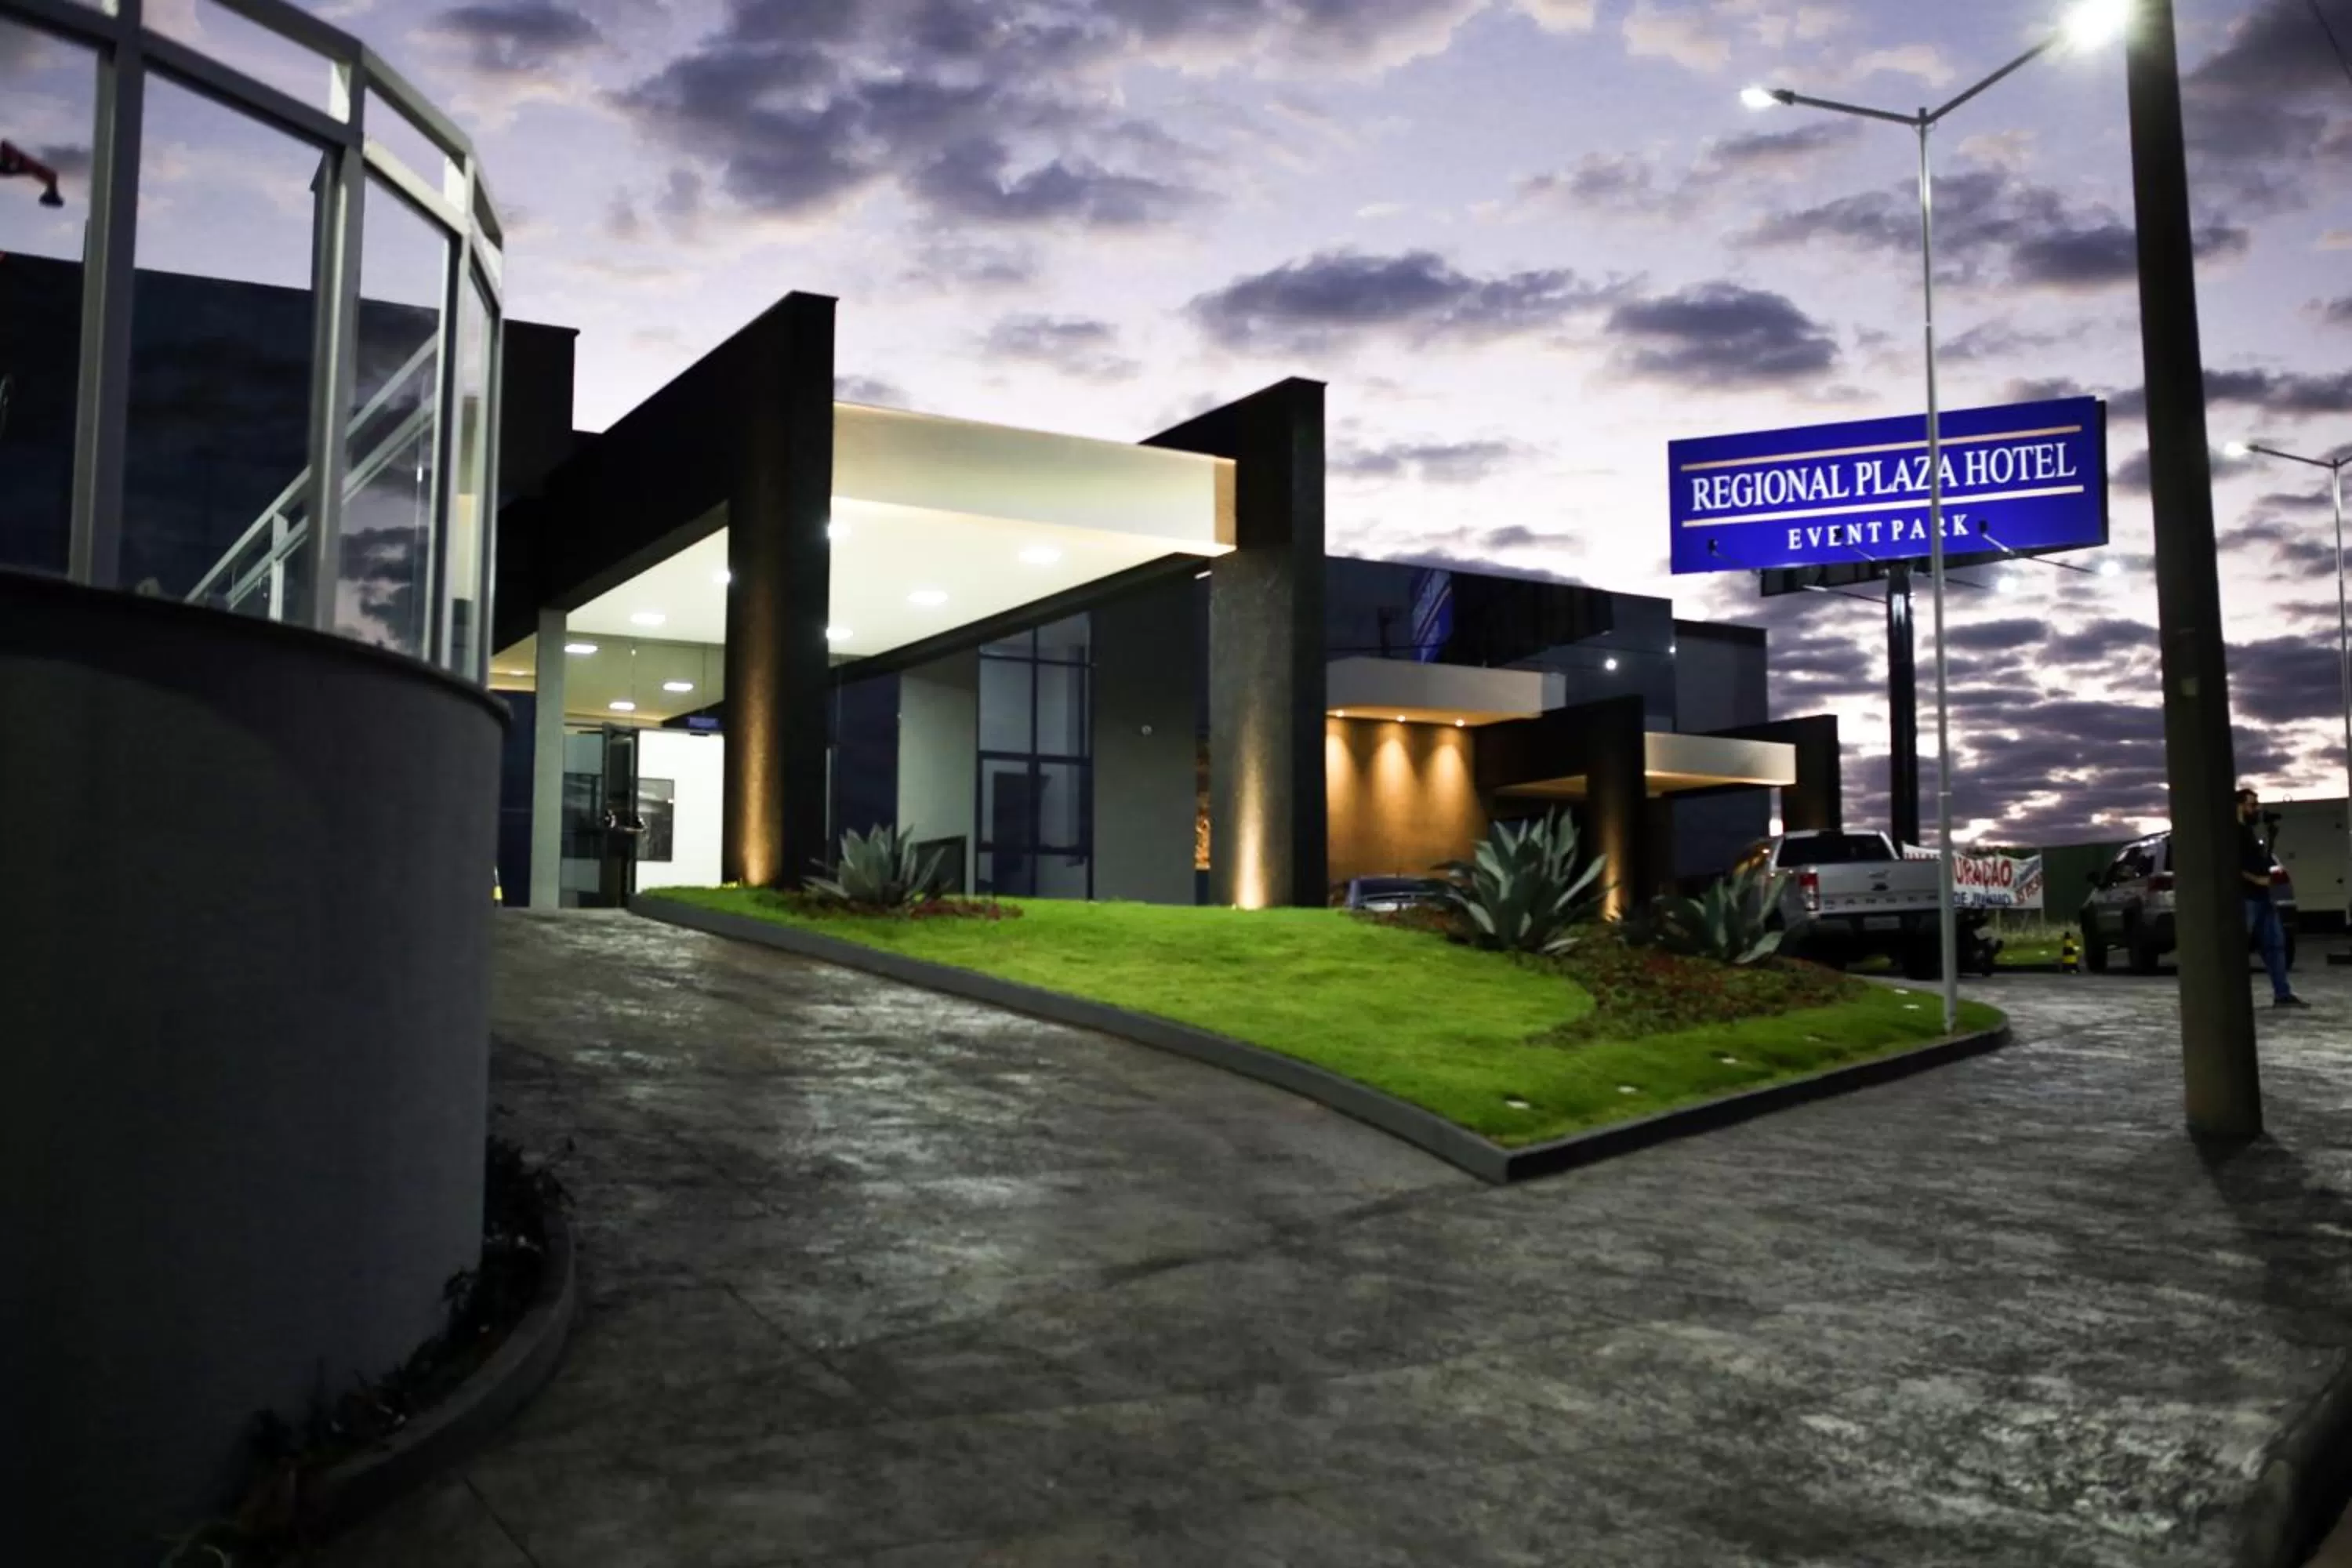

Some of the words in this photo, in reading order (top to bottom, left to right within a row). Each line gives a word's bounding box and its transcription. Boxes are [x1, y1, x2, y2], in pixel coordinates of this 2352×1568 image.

[1691, 464, 1850, 511] REGIONAL
[1854, 453, 1958, 496] PLAZA
[1964, 442, 2078, 486] HOTEL
[1788, 521, 1882, 550] EVENT
[1890, 514, 1970, 541] PARK
